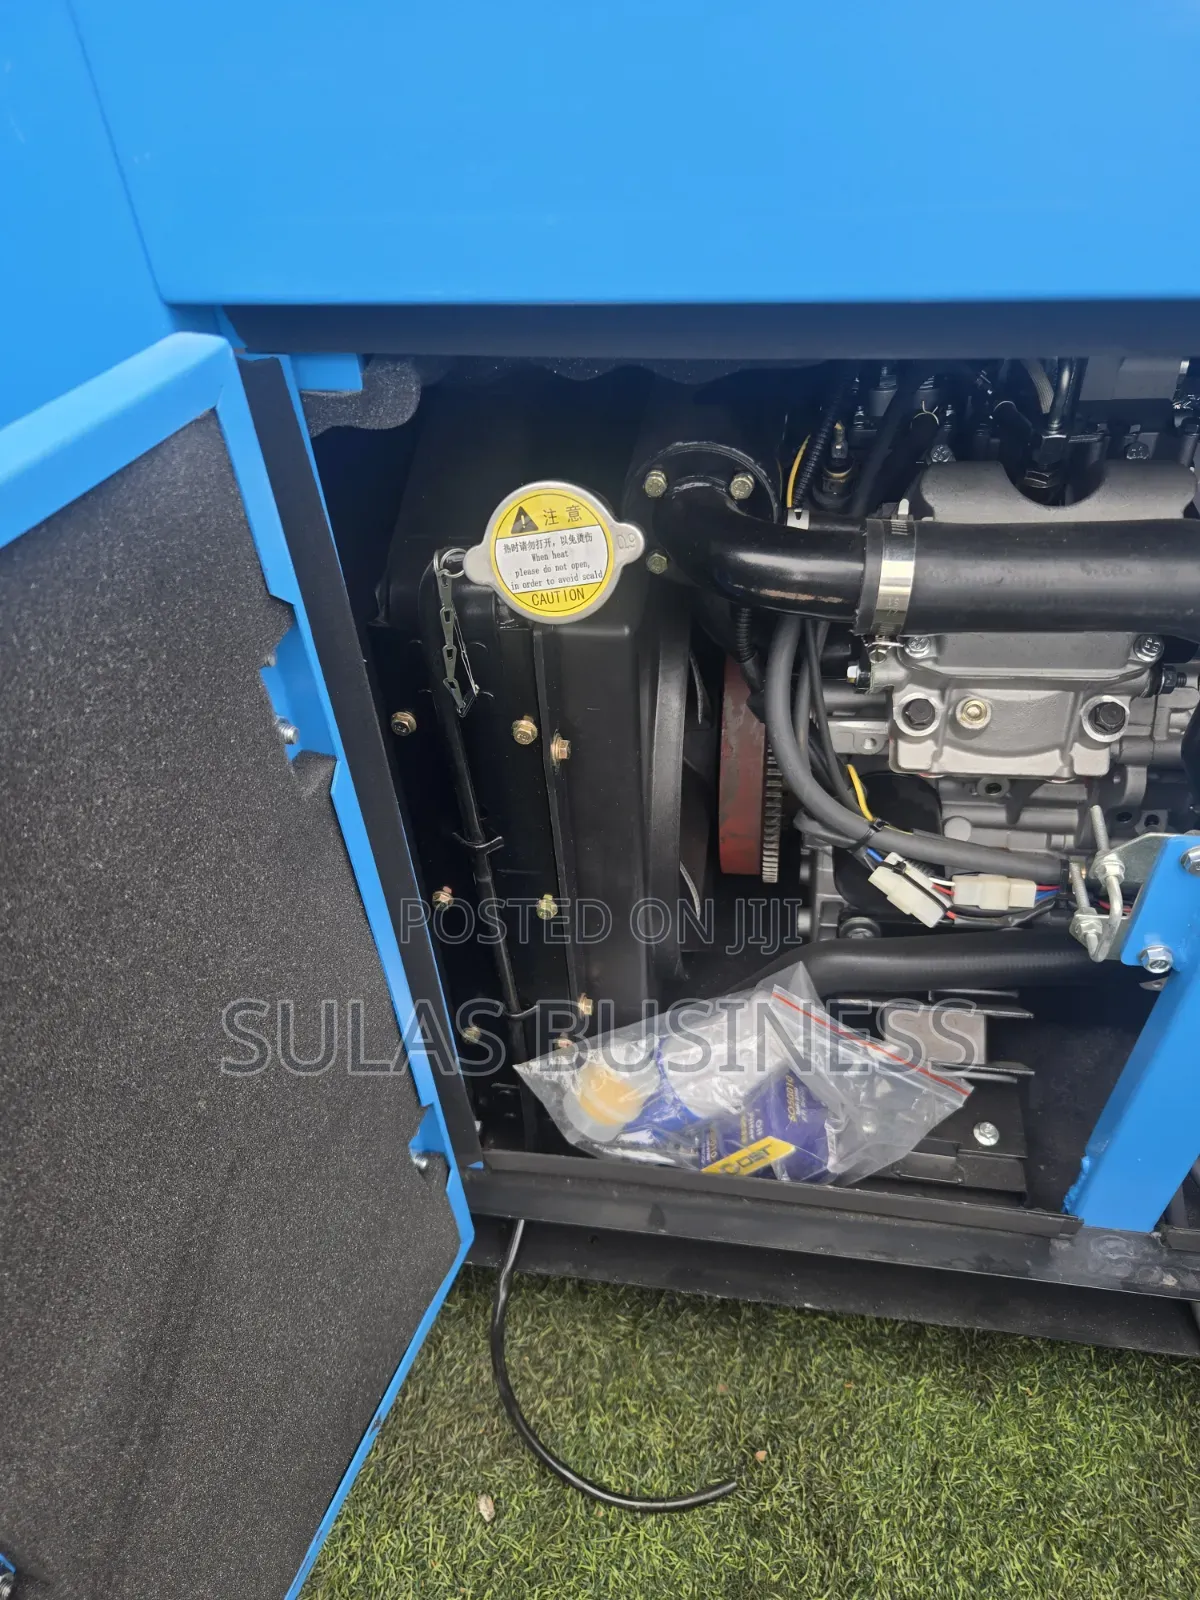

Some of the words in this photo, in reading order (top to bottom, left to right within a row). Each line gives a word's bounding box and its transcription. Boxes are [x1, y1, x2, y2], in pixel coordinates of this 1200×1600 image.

[543, 504, 583, 526] 注意
[531, 553, 549, 562] When
[552, 550, 569, 559] heat
[514, 568, 539, 579] please
[543, 564, 552, 574] do
[555, 563, 568, 572] not
[571, 560, 590, 570] open,
[511, 581, 519, 591] in
[522, 578, 542, 589] order
[546, 577, 555, 586] to
[558, 574, 579, 584] avoid
[582, 570, 603, 581] scald
[531, 587, 585, 606] CAUTION
